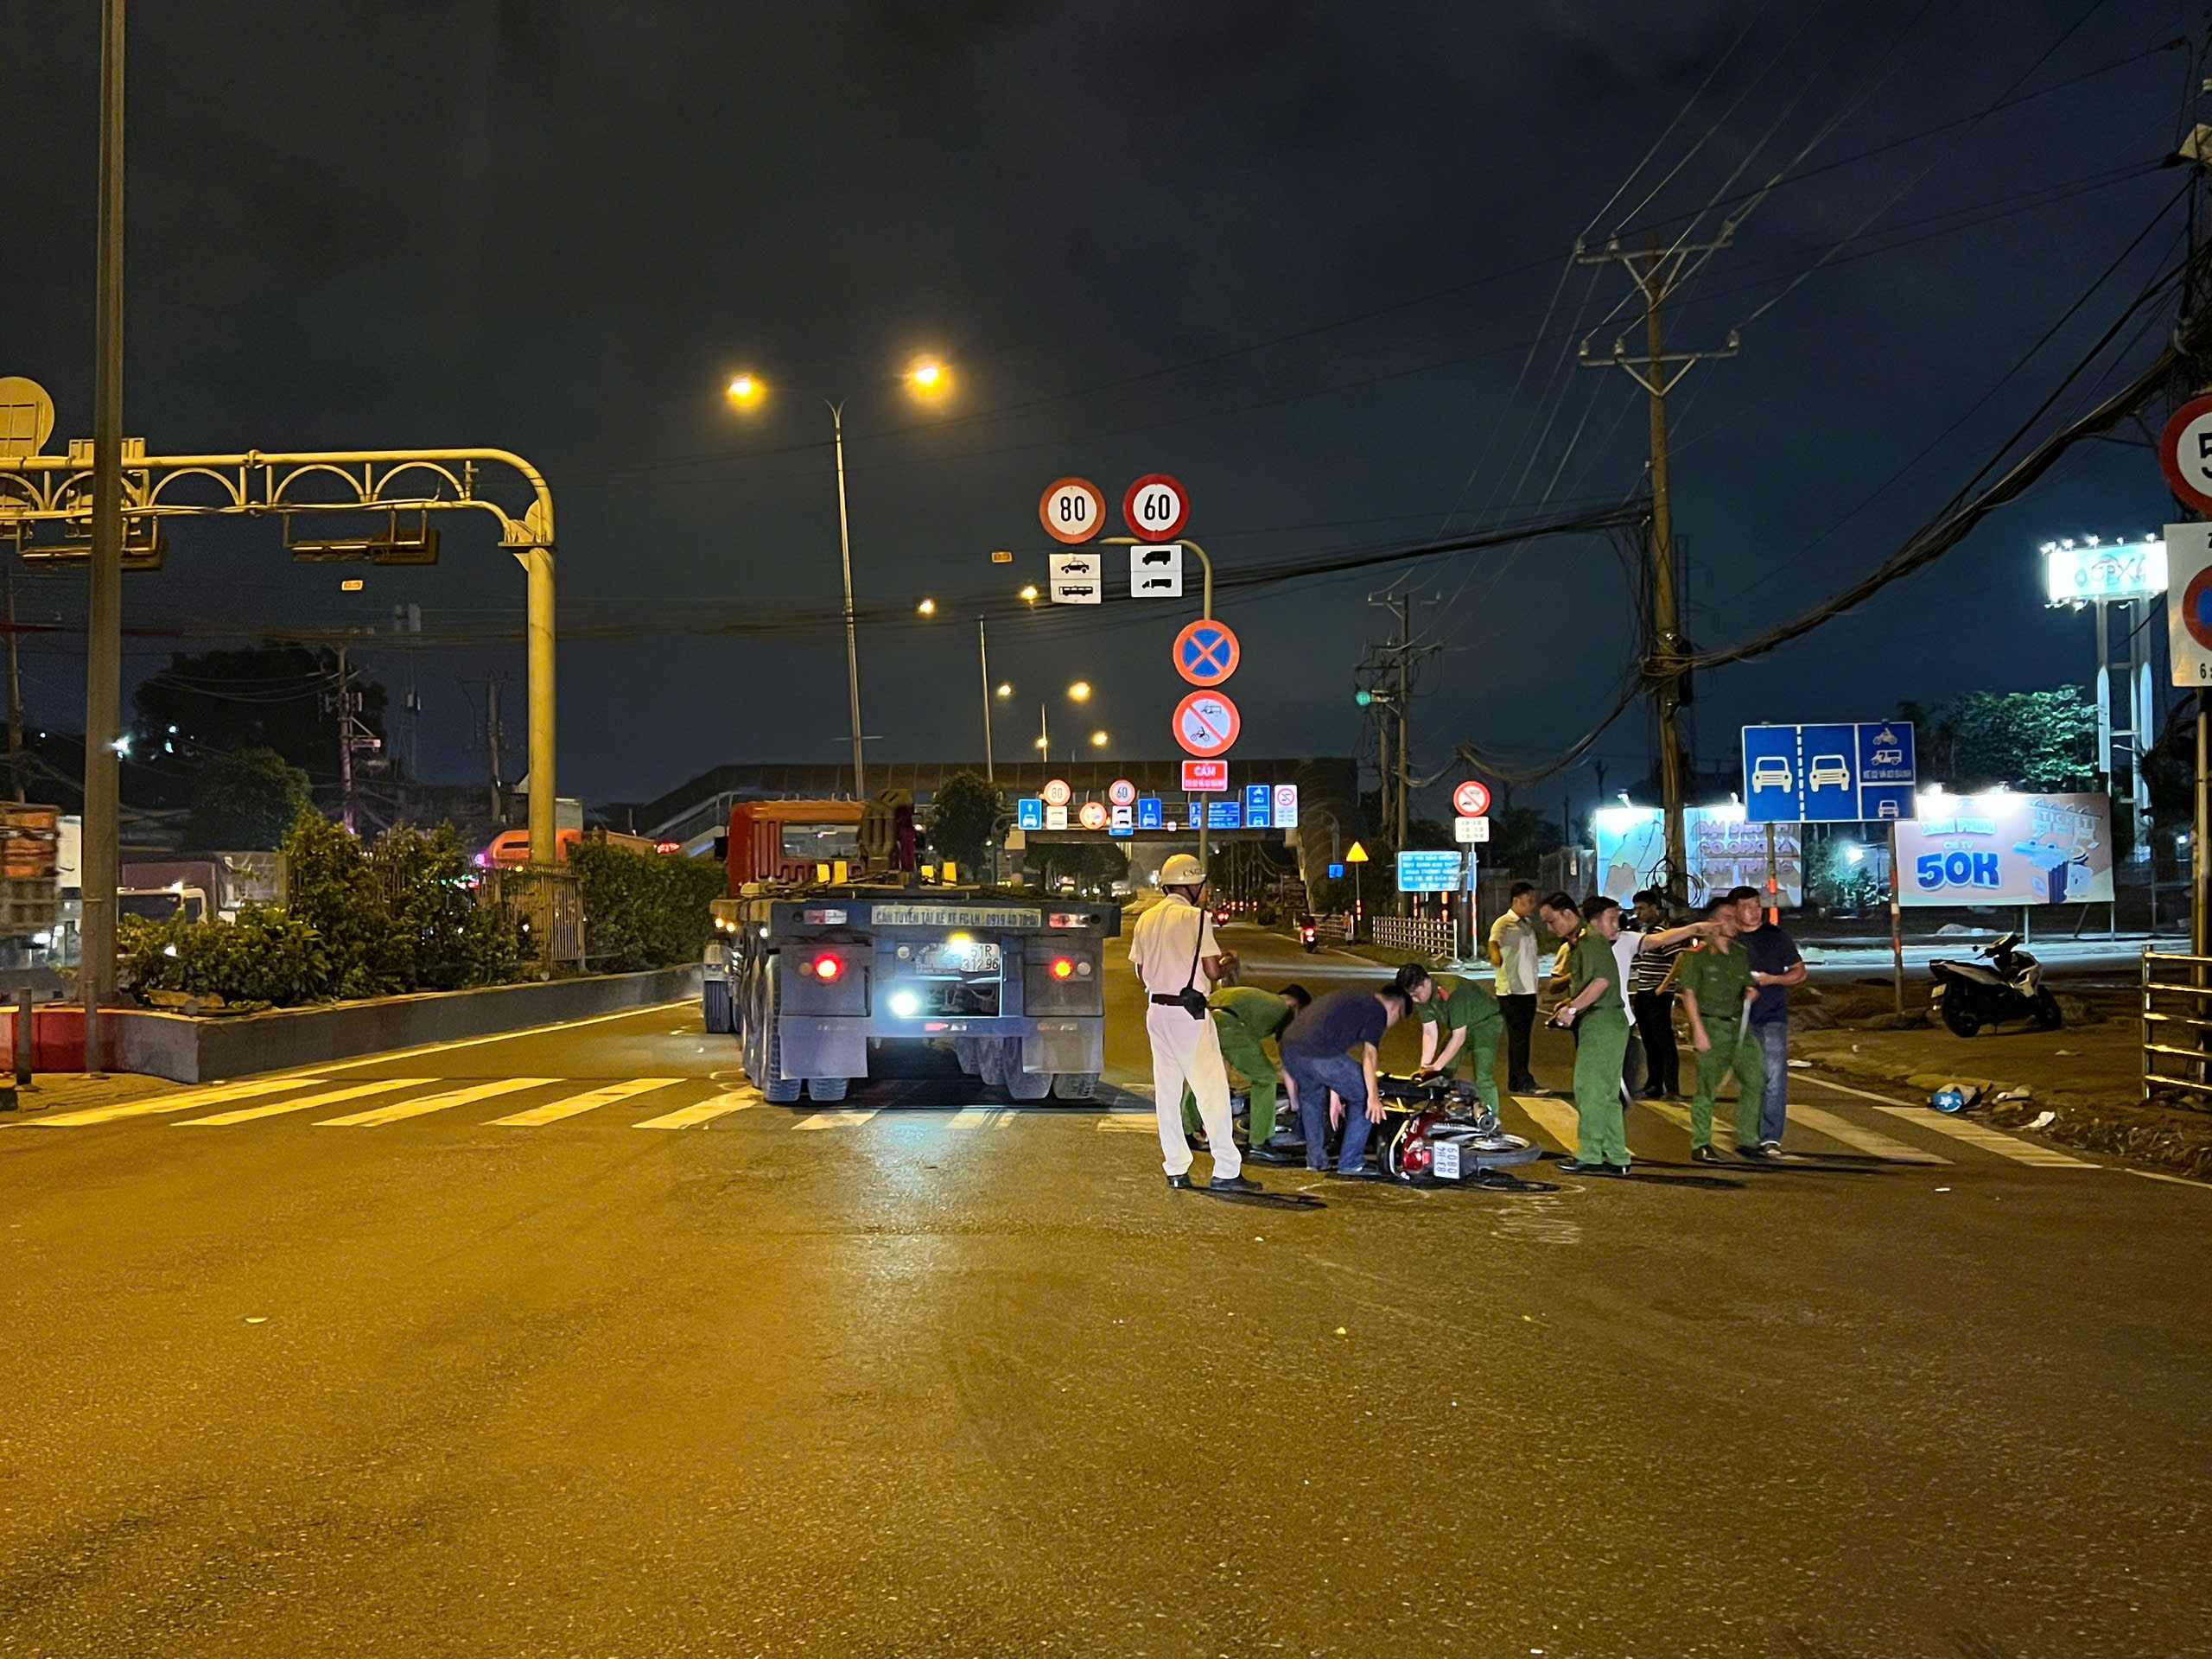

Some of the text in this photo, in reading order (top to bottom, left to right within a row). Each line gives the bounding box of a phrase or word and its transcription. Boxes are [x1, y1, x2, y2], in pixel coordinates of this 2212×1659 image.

[1060, 496, 1085, 522] 80
[1144, 494, 1171, 520] 60
[1052, 787, 1063, 798] 80
[1117, 787, 1128, 798] 60
[1916, 852, 2000, 889] 50K
